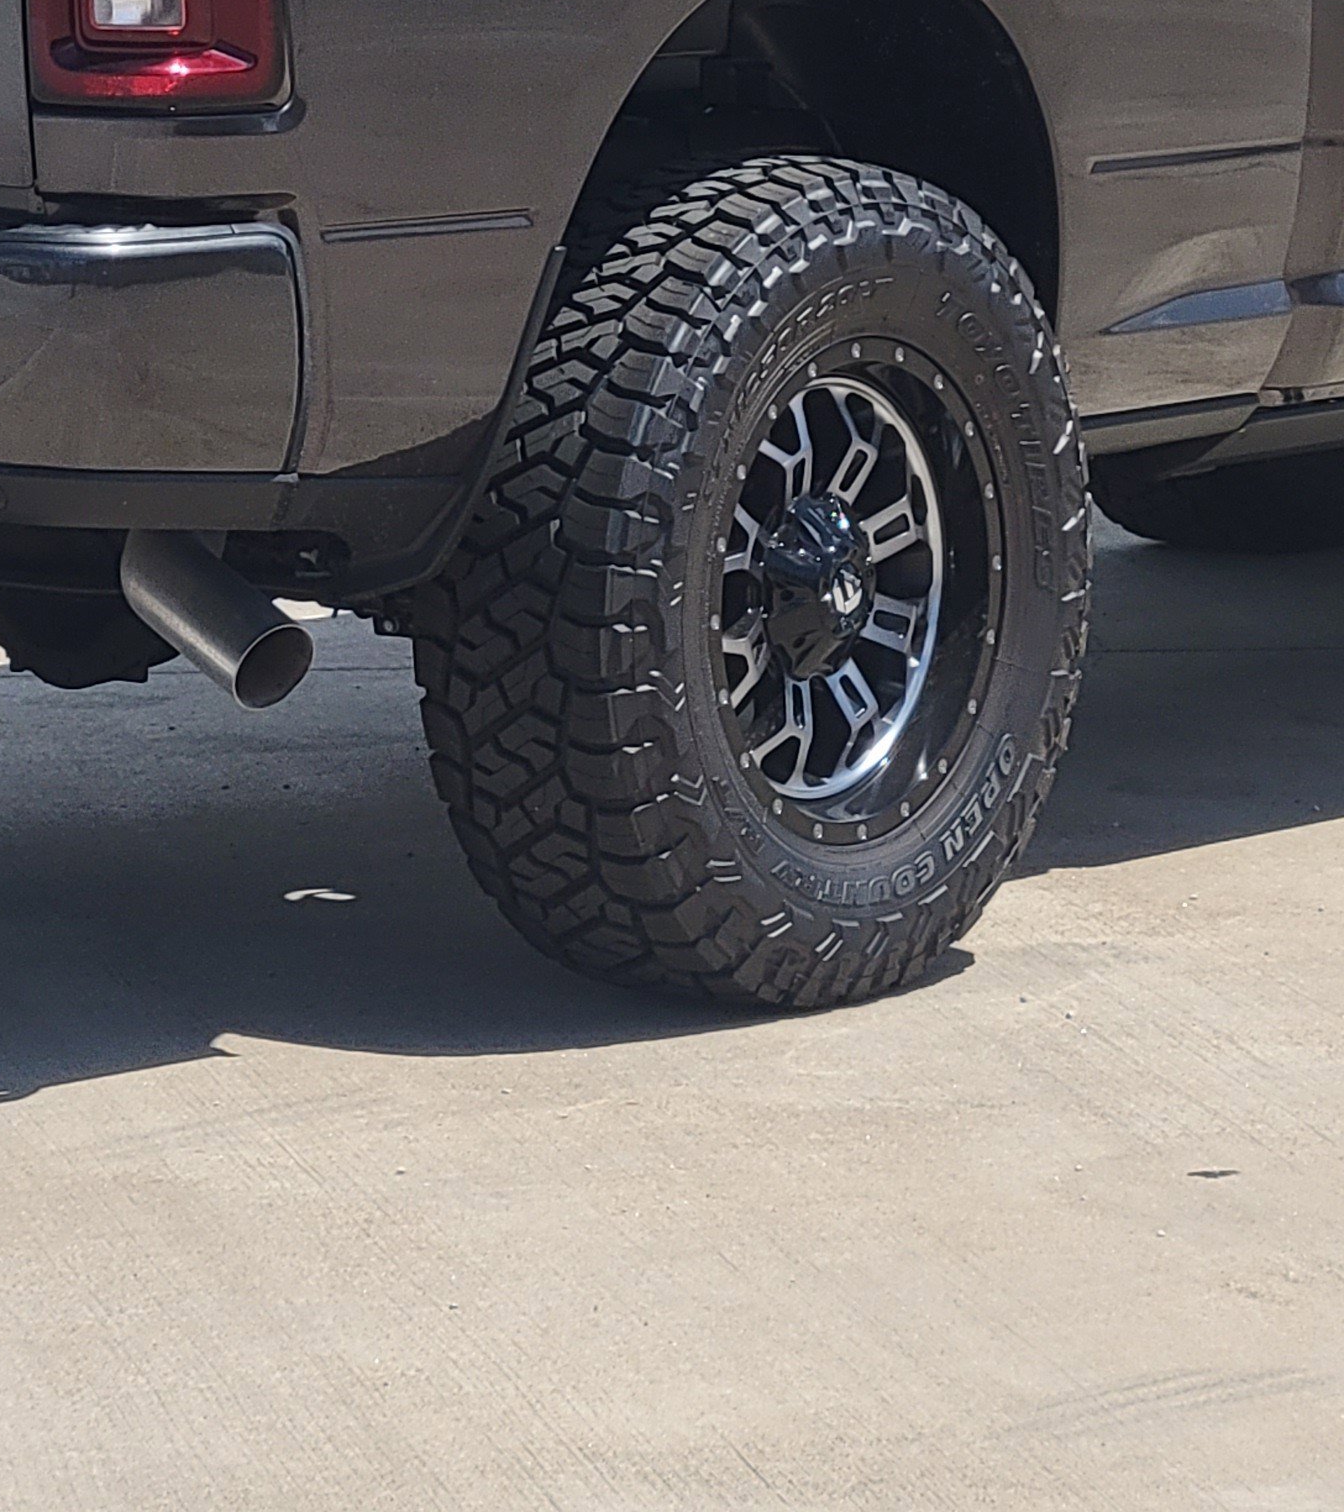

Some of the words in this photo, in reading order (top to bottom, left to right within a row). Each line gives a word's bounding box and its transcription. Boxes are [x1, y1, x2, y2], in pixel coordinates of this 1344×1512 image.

[936, 291, 1021, 396] TOYO
[939, 733, 1015, 861] OPEN
[770, 850, 936, 905] COUNTRY
